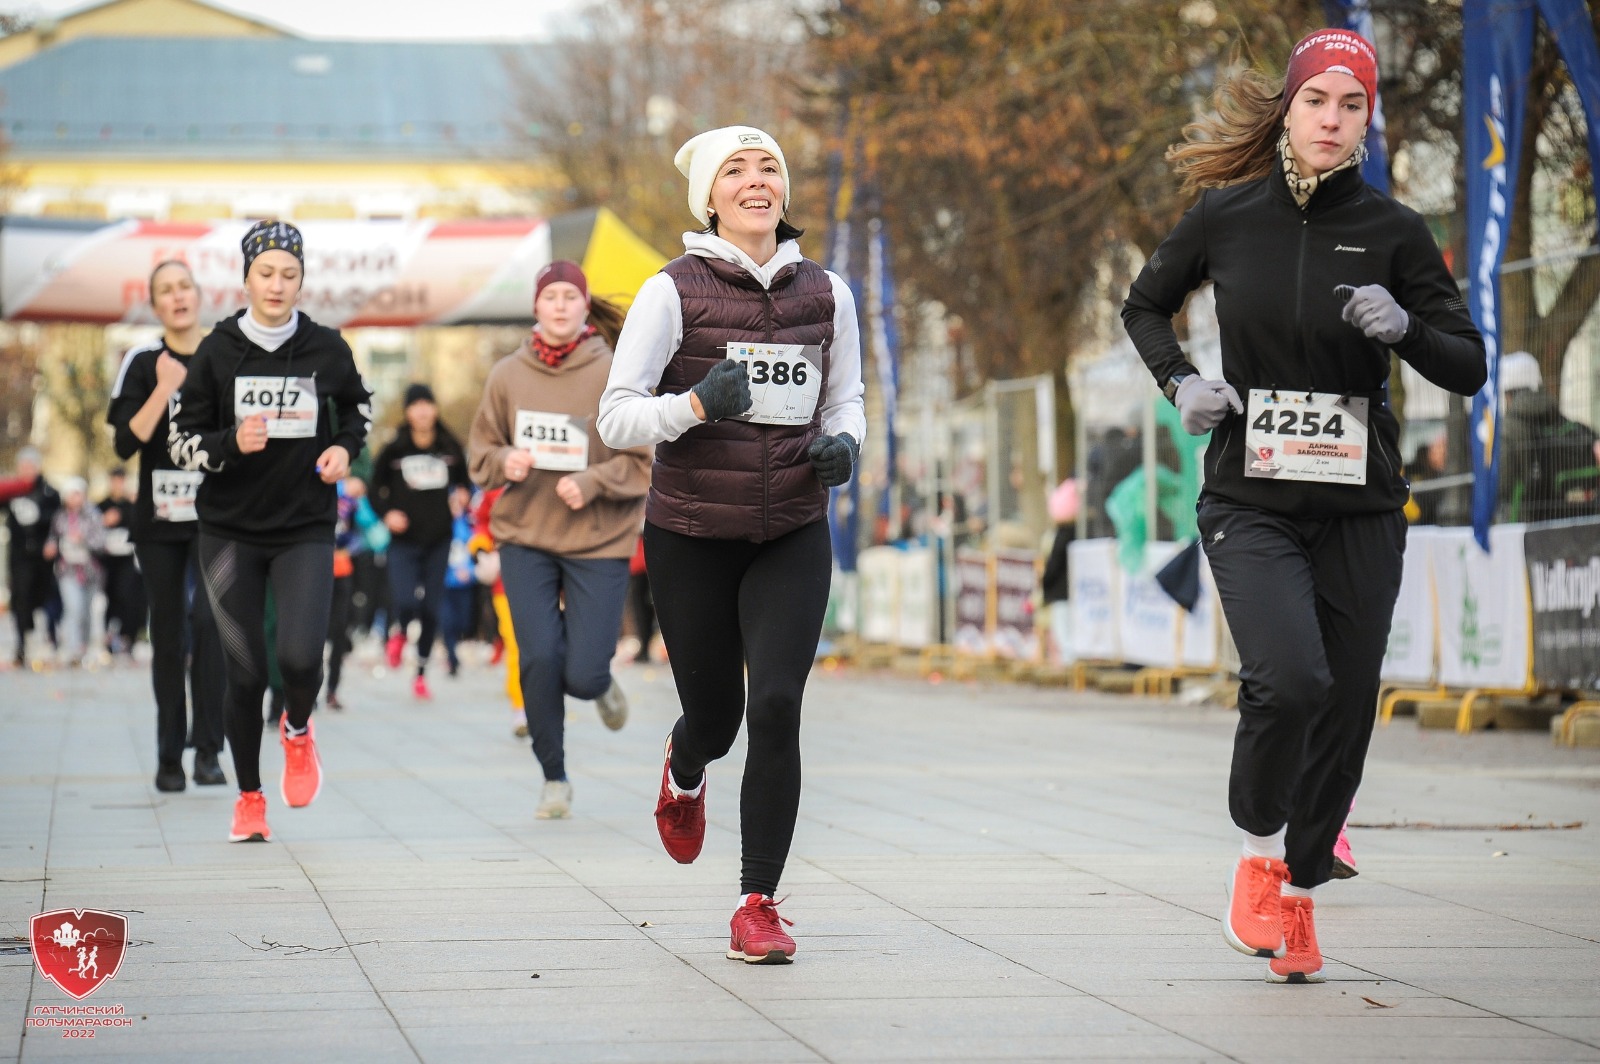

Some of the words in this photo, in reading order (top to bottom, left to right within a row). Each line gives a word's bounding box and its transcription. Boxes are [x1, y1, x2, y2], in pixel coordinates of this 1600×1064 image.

[1295, 33, 1376, 64] GATCHINARUN
[1324, 42, 1359, 54] 2019
[150, 246, 398, 277] ГАТЧКИЙ
[121, 279, 428, 311] ПУРАФОН
[739, 360, 807, 386] 386
[241, 390, 300, 406] 4017
[523, 425, 568, 442] 4311
[1252, 409, 1345, 438] 4254
[1297, 449, 1349, 458] ЗАБОЛОТСКАЯ
[158, 483, 198, 496] 427
[1531, 556, 1600, 619] WalkingP
